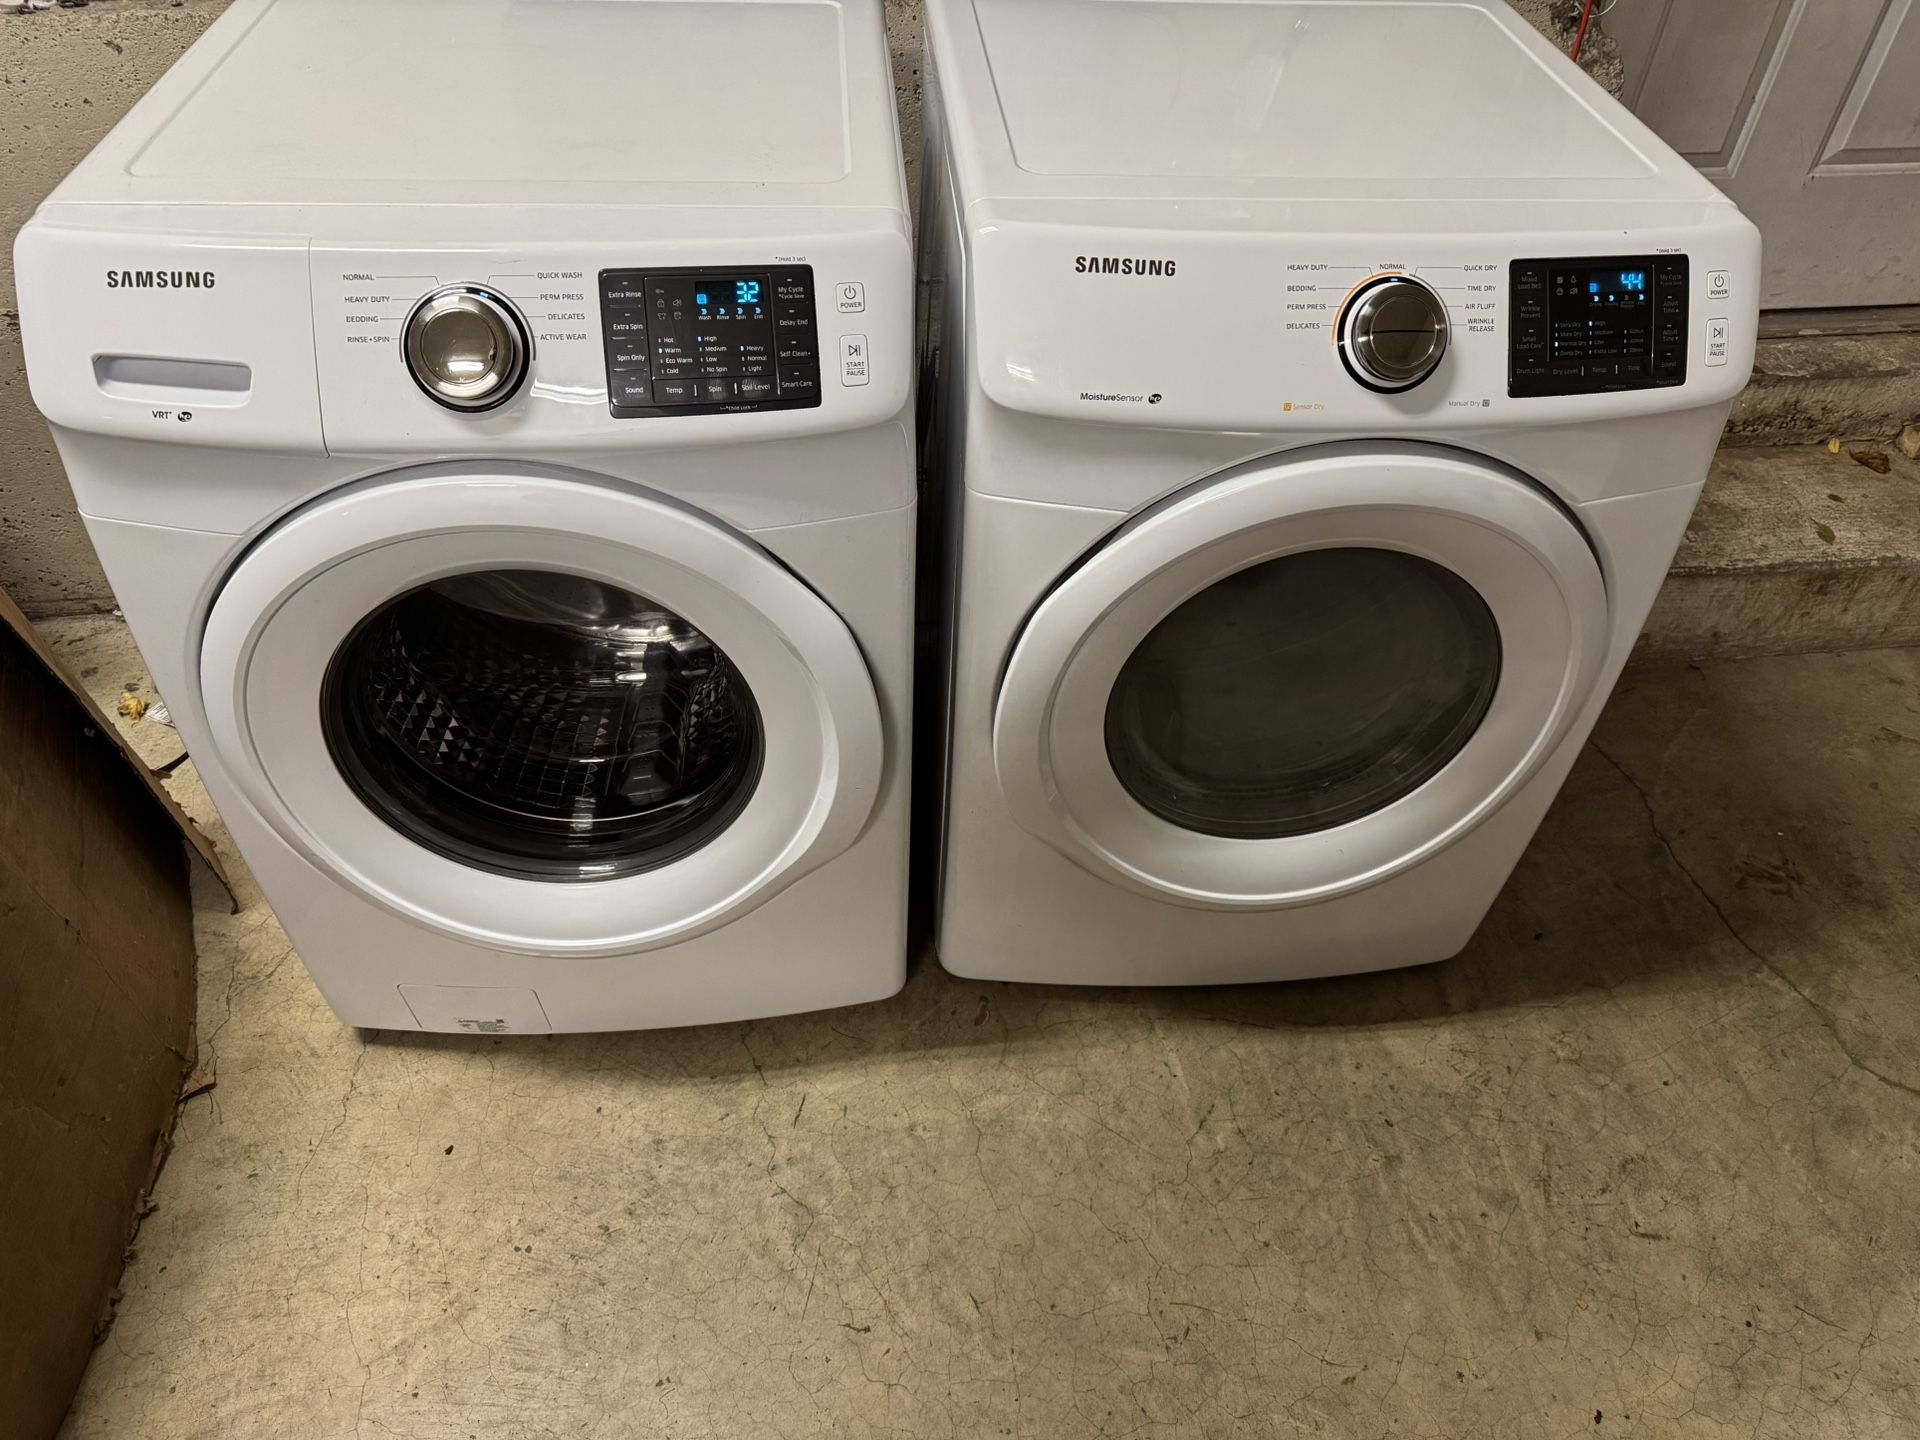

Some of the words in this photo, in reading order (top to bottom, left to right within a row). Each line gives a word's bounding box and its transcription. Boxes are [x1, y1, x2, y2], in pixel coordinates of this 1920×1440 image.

[1075, 256, 1176, 276] SAMSUNG
[1464, 264, 1482, 272] QUICK
[1484, 264, 1497, 272] DRY
[107, 270, 216, 289] SAMSUNG
[537, 272, 560, 280] QUICK
[1620, 272, 1645, 290] 44
[736, 281, 760, 304] 32
[347, 336, 390, 344] RINSE+SPIN
[616, 354, 630, 362] Spin
[631, 354, 646, 362] Only
[716, 366, 728, 374] Spin
[625, 386, 644, 394] Sound
[1080, 392, 1144, 402] MoistureSensor
[1313, 403, 1325, 412] Dry
[1448, 400, 1468, 408] Manual
[1470, 400, 1480, 408] Dry
